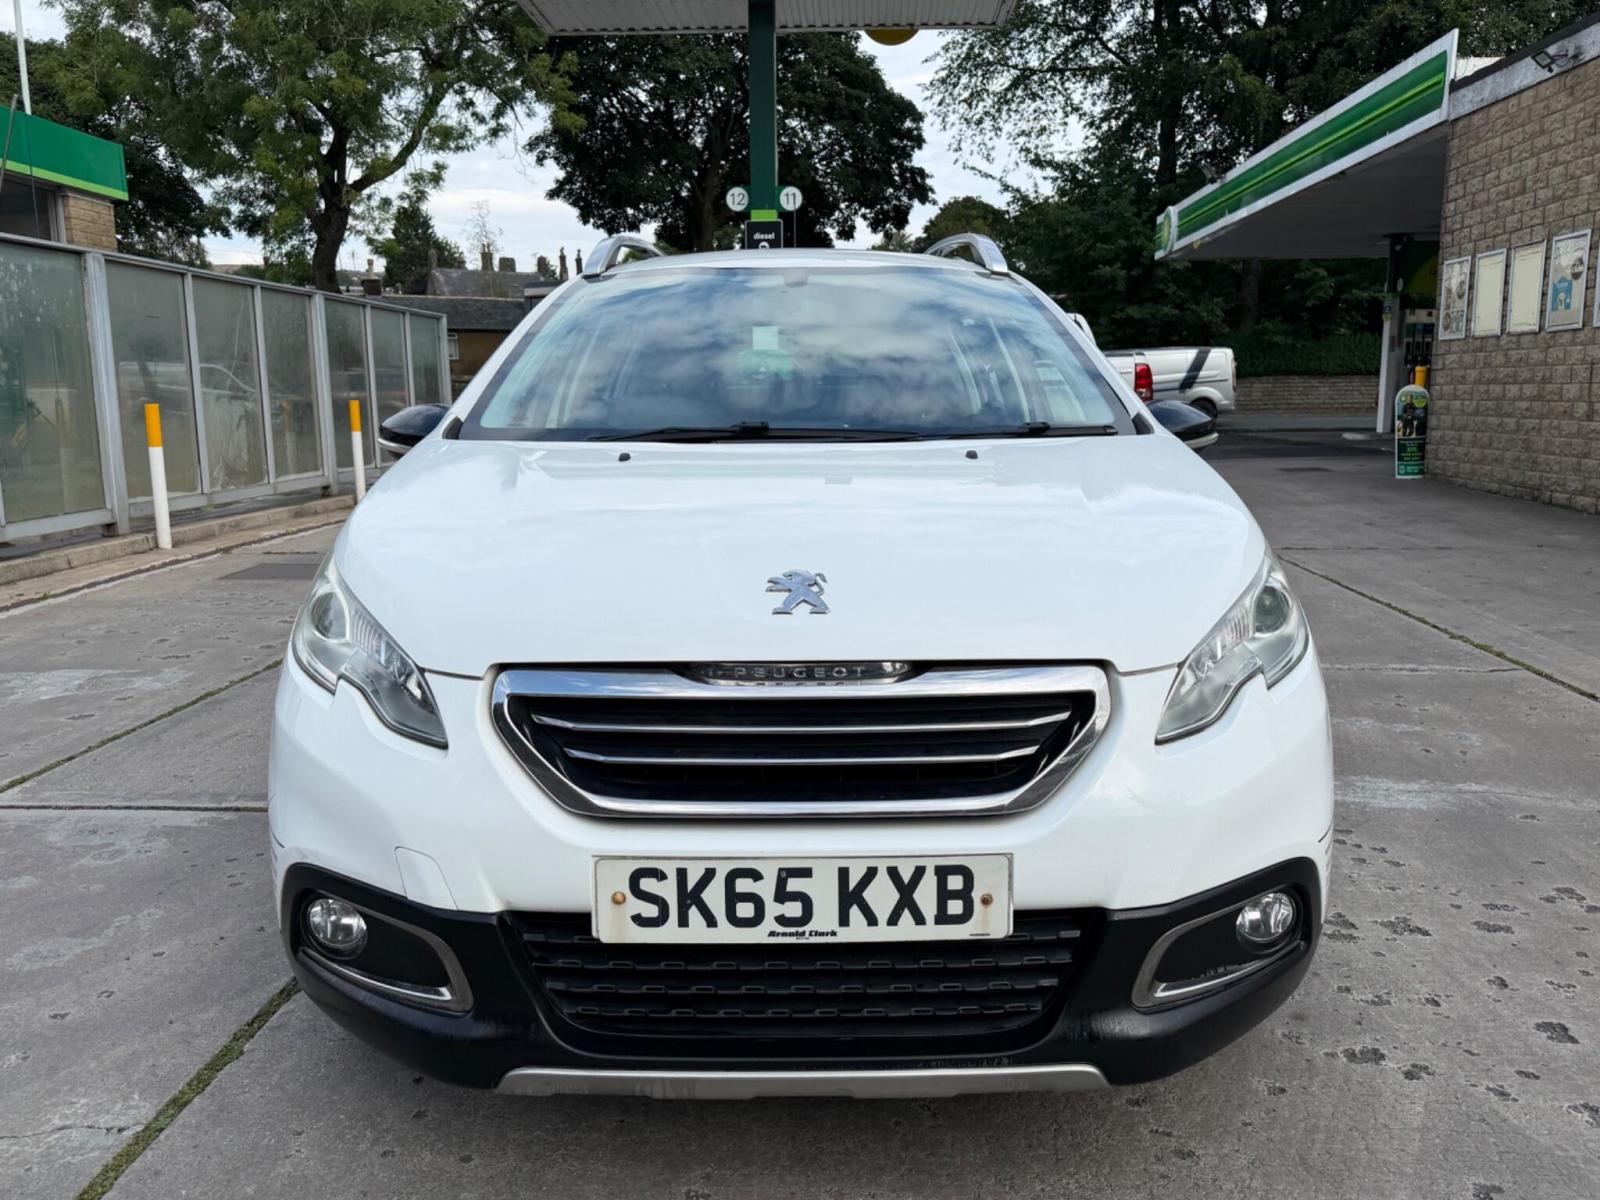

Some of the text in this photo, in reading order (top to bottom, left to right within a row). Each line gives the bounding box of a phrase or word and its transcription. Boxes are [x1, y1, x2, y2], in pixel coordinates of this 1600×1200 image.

[729, 192, 746, 206] 12
[785, 192, 797, 206] 11
[753, 231, 775, 240] diesel
[734, 666, 866, 678] PEUGEOT
[628, 864, 975, 928] SK65 KXB
